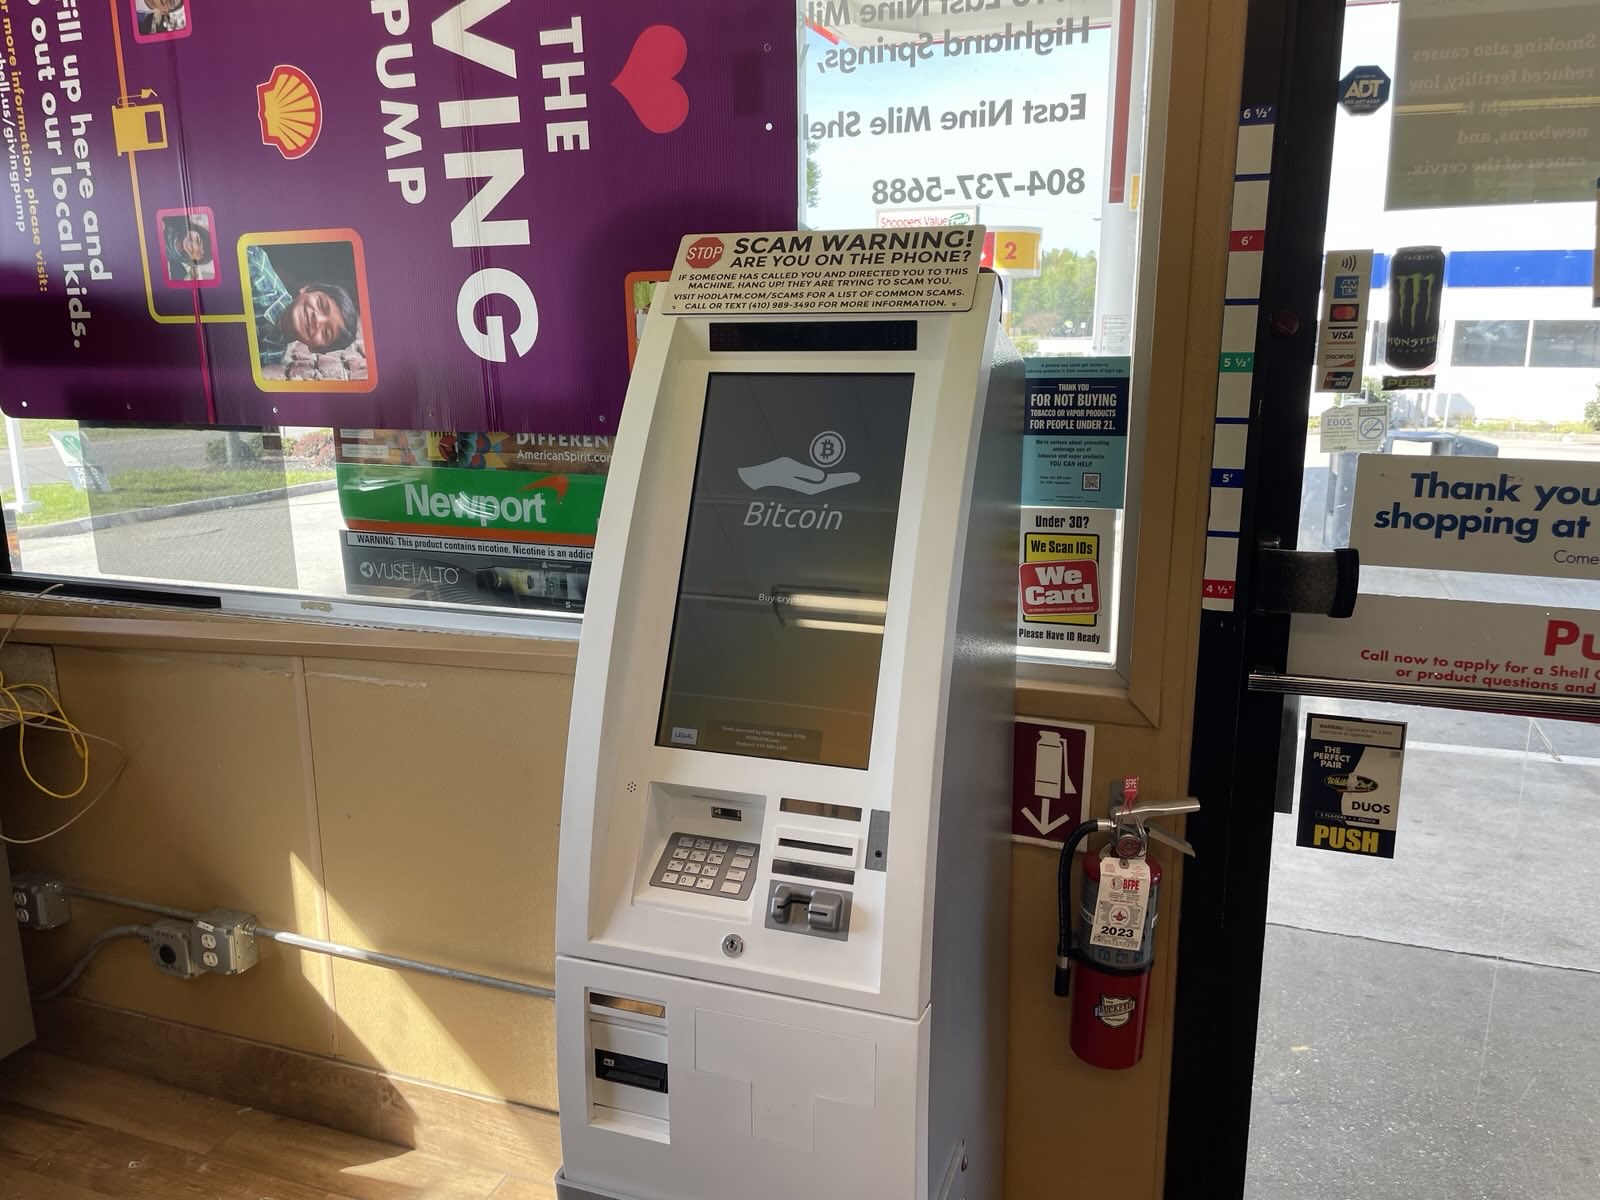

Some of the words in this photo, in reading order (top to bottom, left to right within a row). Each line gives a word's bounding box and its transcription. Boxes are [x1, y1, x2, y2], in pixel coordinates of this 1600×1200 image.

[31, 17, 56, 81] out
[59, 55, 82, 102] up
[539, 16, 590, 153] THE
[1344, 80, 1384, 98] ADT
[371, 0, 427, 204] PUMP
[1243, 109, 1251, 119] 6
[41, 92, 62, 155] our
[0, 52, 26, 232] hell.us/givingpump
[3, 17, 17, 67] more
[11, 71, 32, 182] information,
[24, 188, 41, 245] please
[35, 251, 49, 292] visit:
[70, 114, 94, 199] here
[51, 167, 82, 251] local
[881, 217, 921, 228] Shoppers
[924, 216, 947, 226] Value
[83, 211, 113, 280] and
[733, 236, 813, 254] SCAM
[822, 230, 975, 252] WARNING!
[687, 247, 723, 260] STOP
[730, 256, 767, 268] ARE
[773, 255, 810, 267] YOU
[815, 253, 844, 266] ON
[850, 252, 886, 264] THE
[891, 250, 972, 264] PHONE?
[689, 273, 737, 281] SOMEONE
[801, 271, 821, 279] YOU
[849, 269, 900, 277] DIRECTED
[688, 282, 735, 290] MACHINE,
[877, 278, 891, 286] TO
[927, 277, 952, 285] YOU.
[1341, 280, 1358, 288] AM
[697, 292, 804, 300] HODLATM.COM/SCAMS
[875, 289, 924, 297] COMMON
[63, 263, 92, 348] kids.
[749, 302, 770, 310] (410)
[772, 301, 816, 309] 989-3490
[840, 300, 869, 308] MORE
[871, 299, 947, 307] INFORMATION.
[1332, 331, 1354, 340] VISA
[1224, 358, 1231, 367] 5
[1387, 378, 1432, 388] PUSH
[1030, 394, 1051, 406] FOR
[1054, 394, 1075, 406] NOT
[1077, 394, 1117, 407] BUYING
[1031, 409, 1056, 417] TOBACCO
[1057, 409, 1066, 417] OR
[1066, 409, 1085, 417] VAPOR
[1086, 409, 1116, 417] PRODUCTS
[1030, 420, 1045, 429] FOR
[1046, 420, 1074, 430] PEOPLE
[1076, 420, 1101, 429] UNDER
[1103, 420, 1115, 430] 21.
[1411, 472, 1523, 502] Thank
[1534, 484, 1600, 511] you
[404, 483, 546, 527] Newport
[744, 501, 843, 530] Bitcoin
[1035, 515, 1065, 528] Under
[1069, 516, 1090, 528] 30?
[1374, 502, 1539, 543] shopping
[1552, 516, 1591, 538] at
[357, 534, 396, 545] WARNING:
[397, 538, 413, 547] This
[414, 539, 442, 549] product
[444, 541, 476, 551] contains
[478, 543, 511, 553] nicotine.
[513, 545, 545, 556] Nicotine
[548, 548, 555, 556] is
[1031, 540, 1046, 552] We
[1049, 541, 1073, 554] Scan
[1076, 541, 1093, 555] IDs
[1553, 550, 1600, 565] Come
[373, 562, 410, 581] VUSE
[418, 566, 459, 584] ALTO
[1035, 566, 1082, 586] We
[1025, 584, 1094, 606] Card
[1206, 584, 1213, 593] 4
[758, 593, 775, 604] Buy
[1018, 628, 1044, 639] Please
[1046, 630, 1064, 641] Have
[1066, 631, 1075, 641] ID
[1077, 632, 1101, 644] Ready
[1361, 650, 1389, 662] Call
[1394, 655, 1428, 665] now
[1434, 657, 1448, 667] to
[1454, 659, 1499, 674] apply
[1505, 661, 1528, 674] for
[1533, 667, 1544, 675] a
[1549, 665, 1589, 679] Shell
[1396, 669, 1413, 677] or
[1417, 670, 1477, 683] product
[1482, 677, 1558, 691] questions
[1564, 683, 1596, 694] and
[675, 732, 694, 740] LEGAL
[1313, 752, 1351, 762] PERFECT
[1324, 746, 1341, 754] THE
[1320, 760, 1342, 769] PAIR
[1351, 801, 1391, 815] DUOS
[1313, 824, 1379, 854] PUSH
[1123, 879, 1140, 890] BFPE
[1101, 926, 1134, 938] 2023
